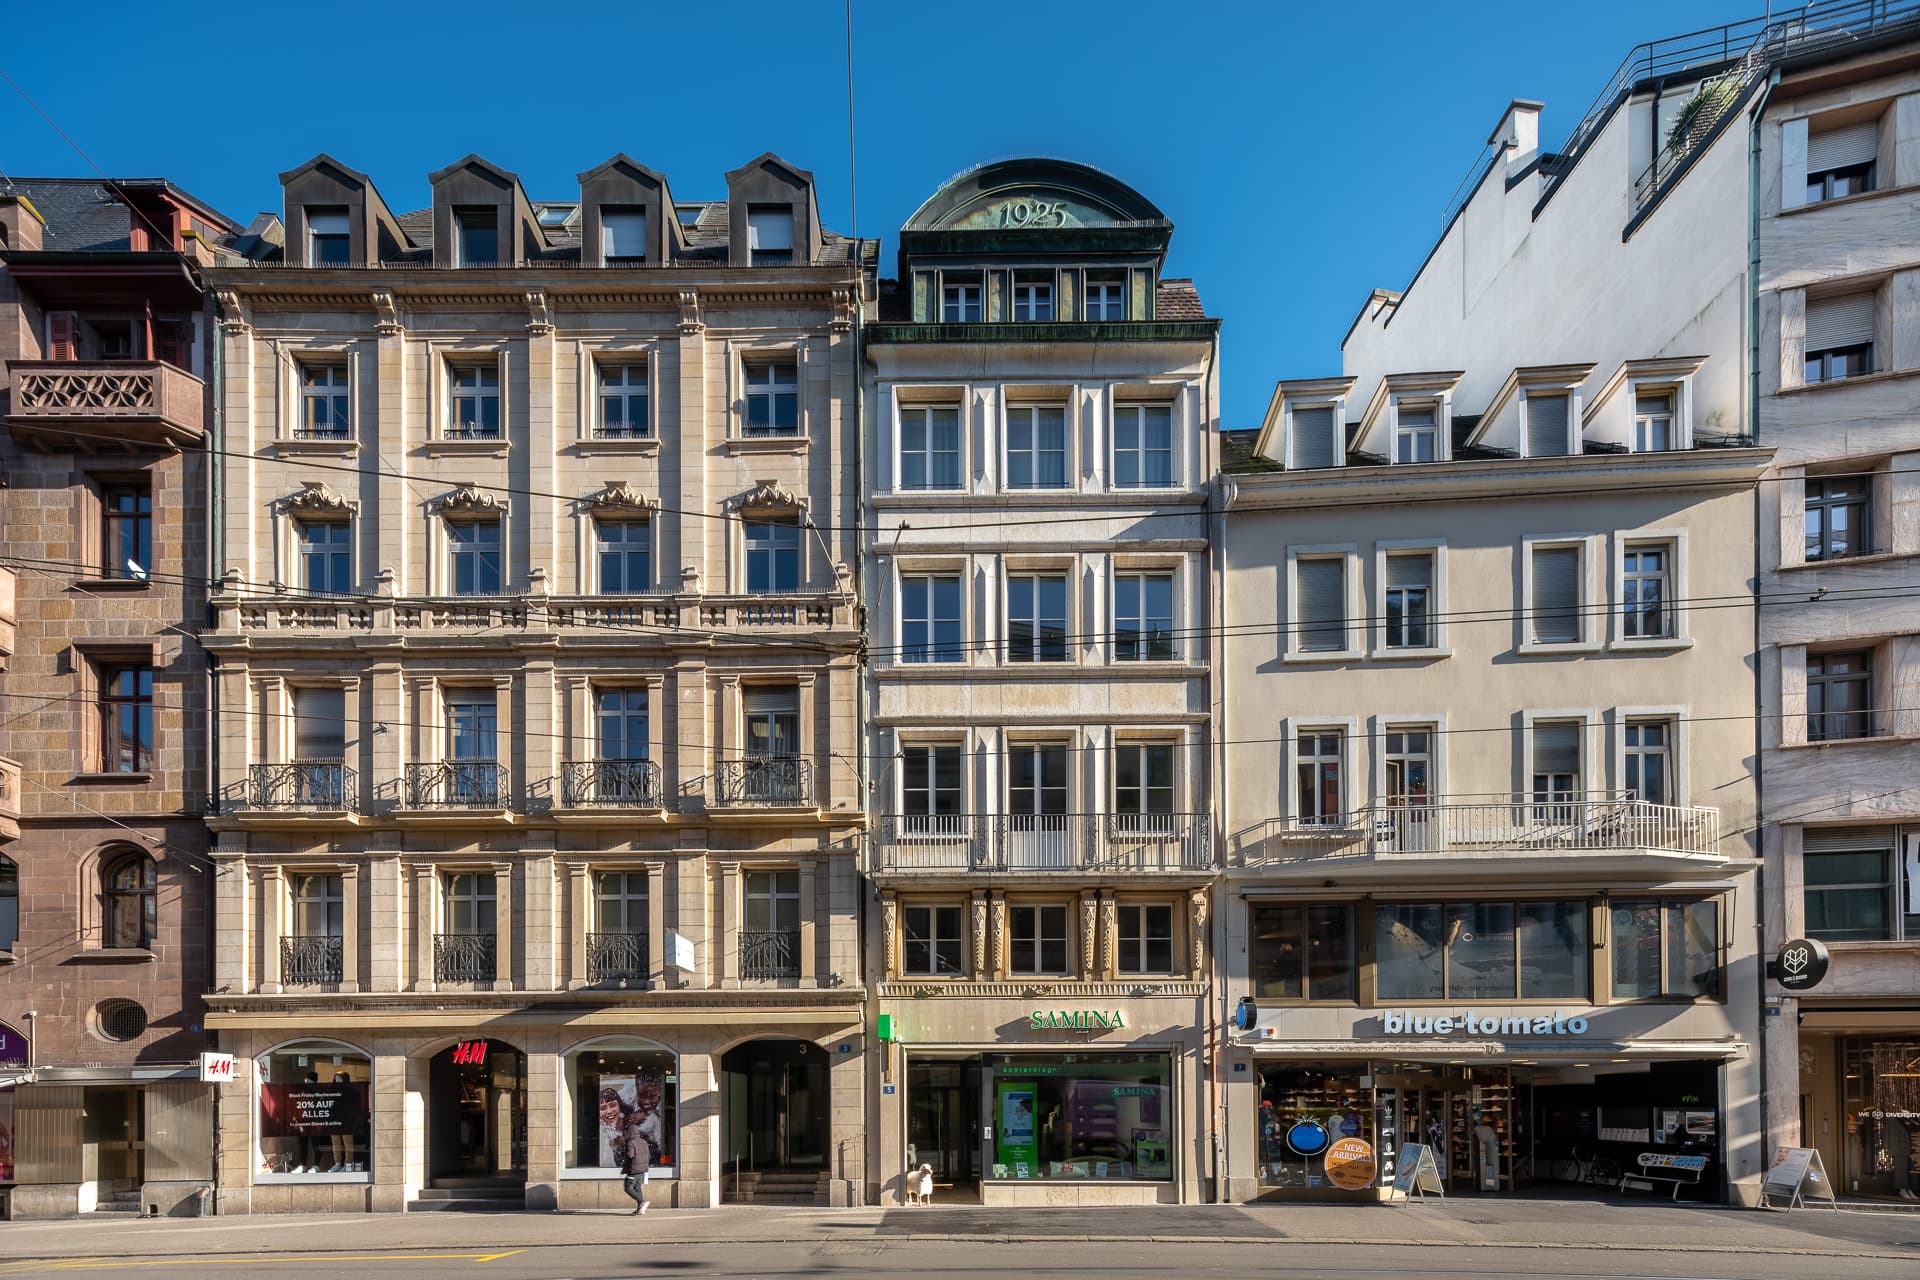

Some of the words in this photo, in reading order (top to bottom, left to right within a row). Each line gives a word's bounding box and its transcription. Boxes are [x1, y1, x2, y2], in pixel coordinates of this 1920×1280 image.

[1001, 202, 1067, 229] 1925
[1030, 1010, 1125, 1029] SAMINA
[1384, 1010, 1589, 1035] blue-tomato
[452, 1042, 487, 1065] H&M
[799, 1044, 807, 1055] 3
[208, 1060, 231, 1075] H&M
[1113, 1087, 1156, 1096] SAMINA
[296, 1101, 315, 1109] 20%
[315, 1100, 335, 1108] AUF
[301, 1110, 330, 1118] ALLES
[1344, 1143, 1364, 1152] NEW
